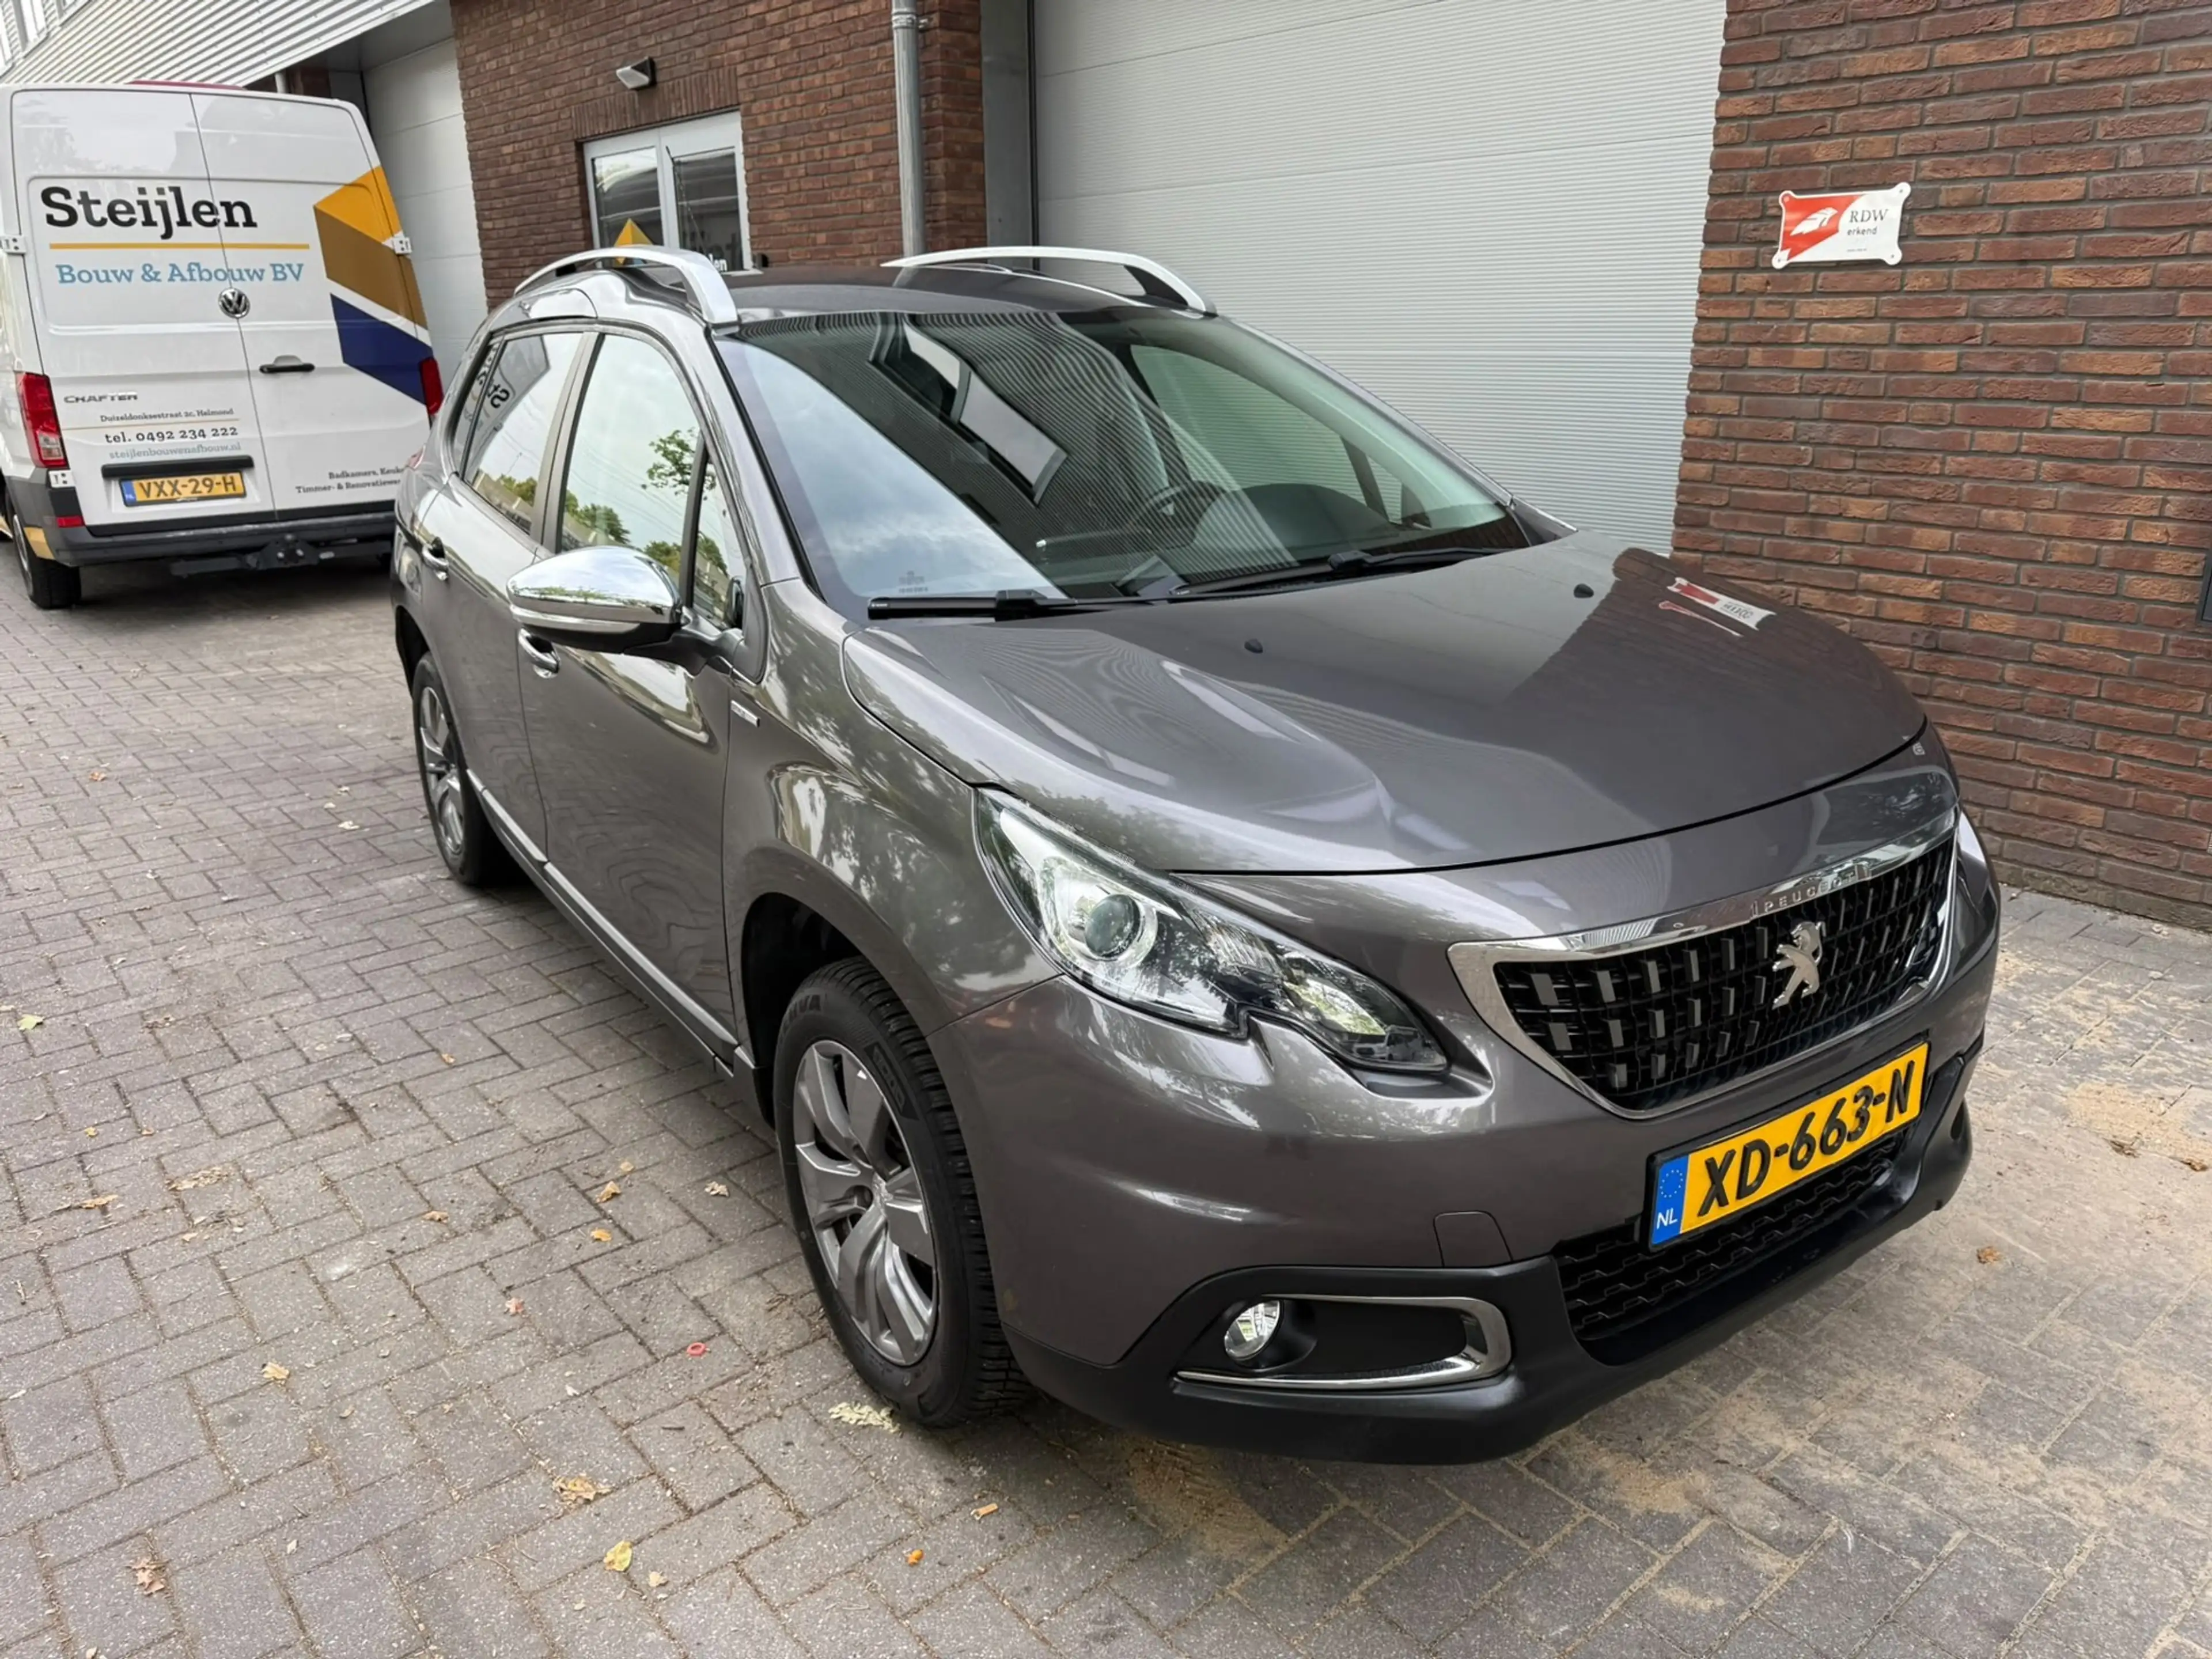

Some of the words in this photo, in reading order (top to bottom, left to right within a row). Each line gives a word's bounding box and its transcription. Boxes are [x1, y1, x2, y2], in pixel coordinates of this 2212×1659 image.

[40, 186, 257, 240] Steijlen
[1849, 209, 1888, 223] RDW
[1847, 226, 1877, 236] erkend
[56, 264, 133, 284] Bouw
[141, 263, 162, 283] &
[168, 262, 266, 283] Afbouw
[270, 263, 305, 282] BV
[196, 407, 234, 417] Helmond
[105, 431, 131, 443] tel.
[136, 431, 175, 442] 0492
[179, 429, 206, 440] 234
[211, 427, 238, 437] 222
[109, 442, 241, 460] steijlenbouwenafbouw.nl
[139, 476, 236, 498] VXX-29-H
[1764, 872, 1855, 912] PEUGEOT
[1698, 1060, 1915, 1217] XD-663-N
[1656, 1207, 1678, 1229] NL
